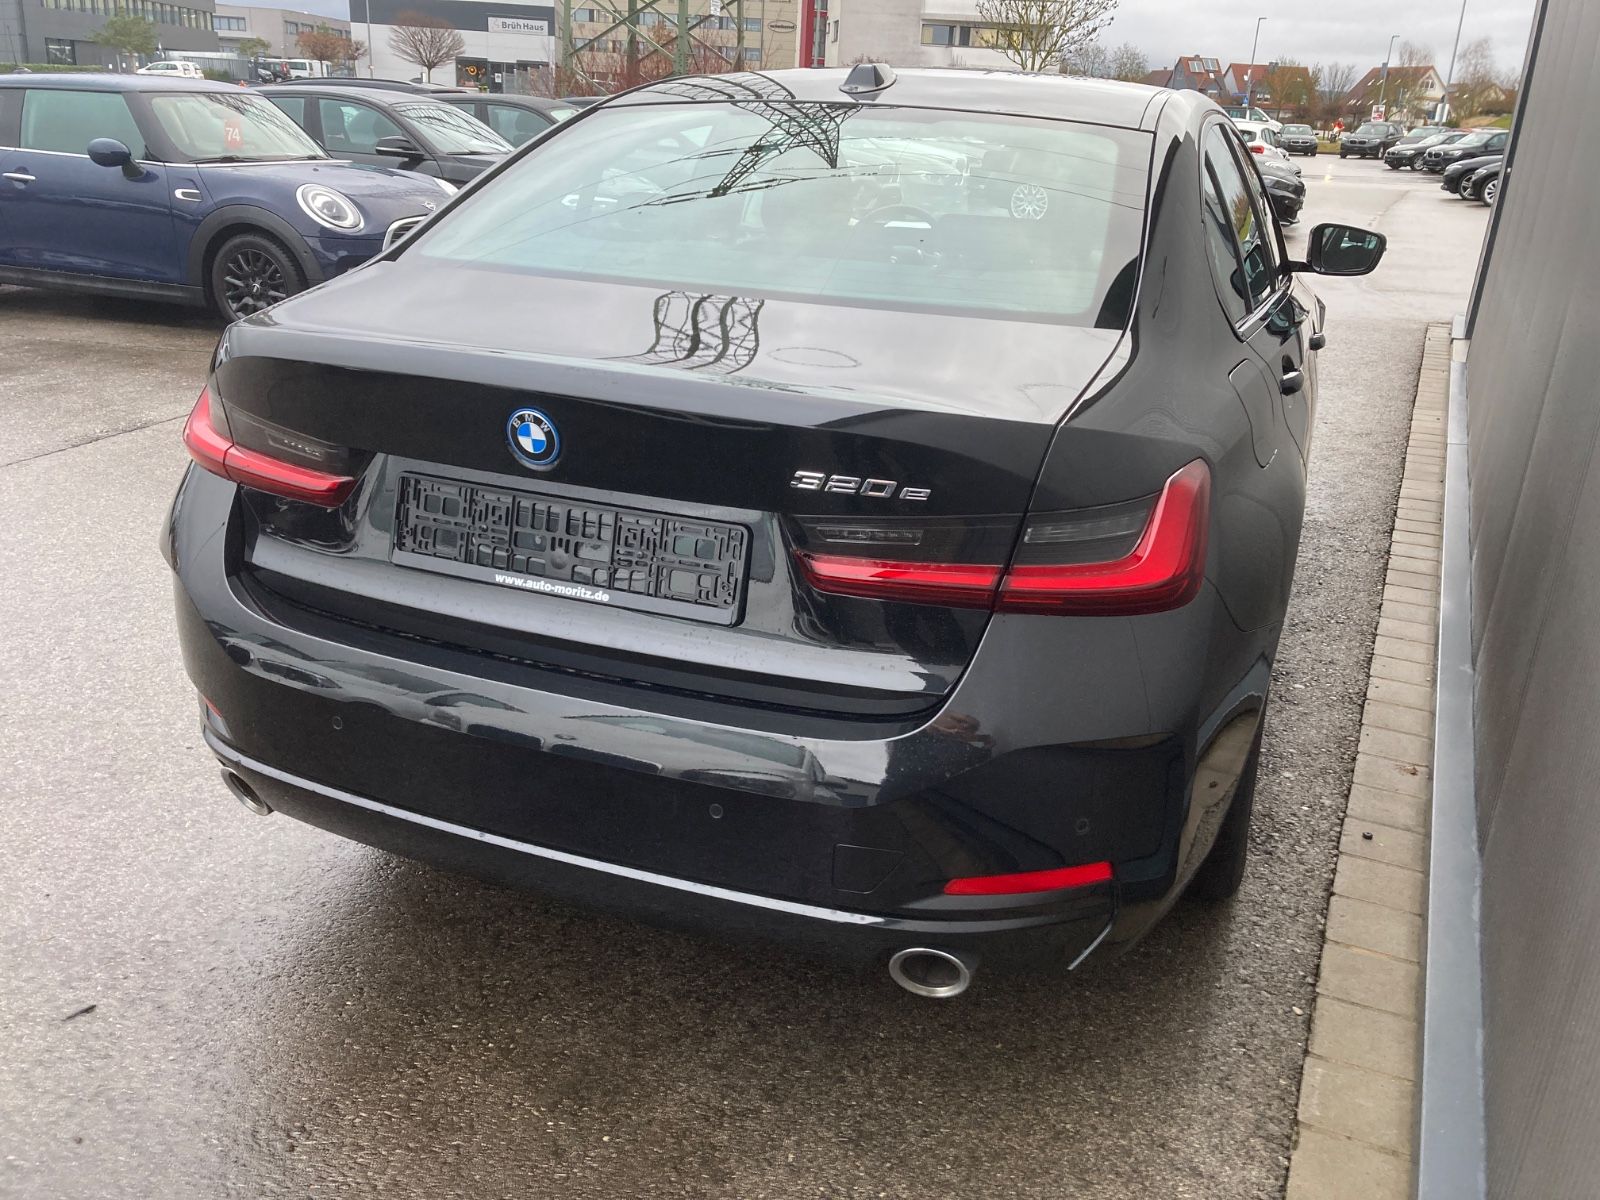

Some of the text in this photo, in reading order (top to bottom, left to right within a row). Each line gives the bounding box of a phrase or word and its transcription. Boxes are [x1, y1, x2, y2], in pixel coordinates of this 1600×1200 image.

[501, 21, 522, 30] Brüh
[523, 22, 544, 31] Haus
[225, 127, 241, 142] 74
[512, 413, 551, 432] BMW
[495, 573, 610, 602] www.auto-moritz.de
